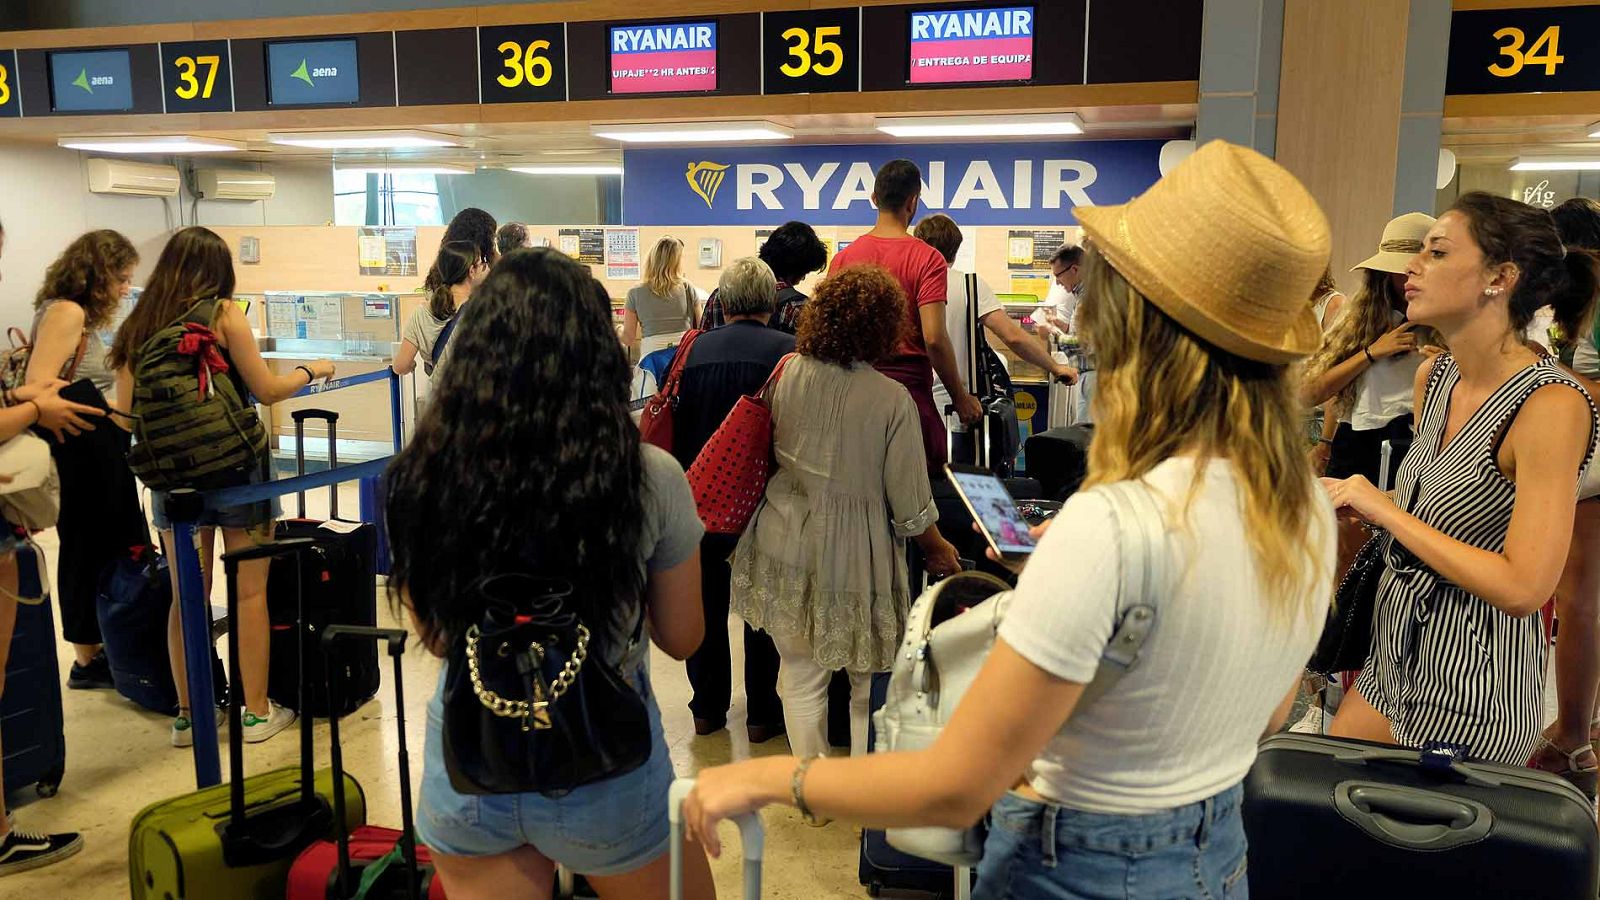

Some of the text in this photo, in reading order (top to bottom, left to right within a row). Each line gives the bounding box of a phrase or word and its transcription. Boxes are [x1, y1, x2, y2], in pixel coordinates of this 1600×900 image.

[613, 26, 712, 51] RYANAIR
[911, 10, 1031, 39] RYANAIR
[496, 40, 552, 88] 36
[779, 26, 844, 78] 35
[918, 57, 969, 67] ENTREGA
[973, 56, 987, 65] DE
[1487, 25, 1564, 77] 34
[91, 76, 114, 86] aena
[174, 55, 219, 99] 37
[312, 66, 337, 77] aena
[661, 68, 674, 76] HR
[736, 160, 1098, 210] RYANAIR
